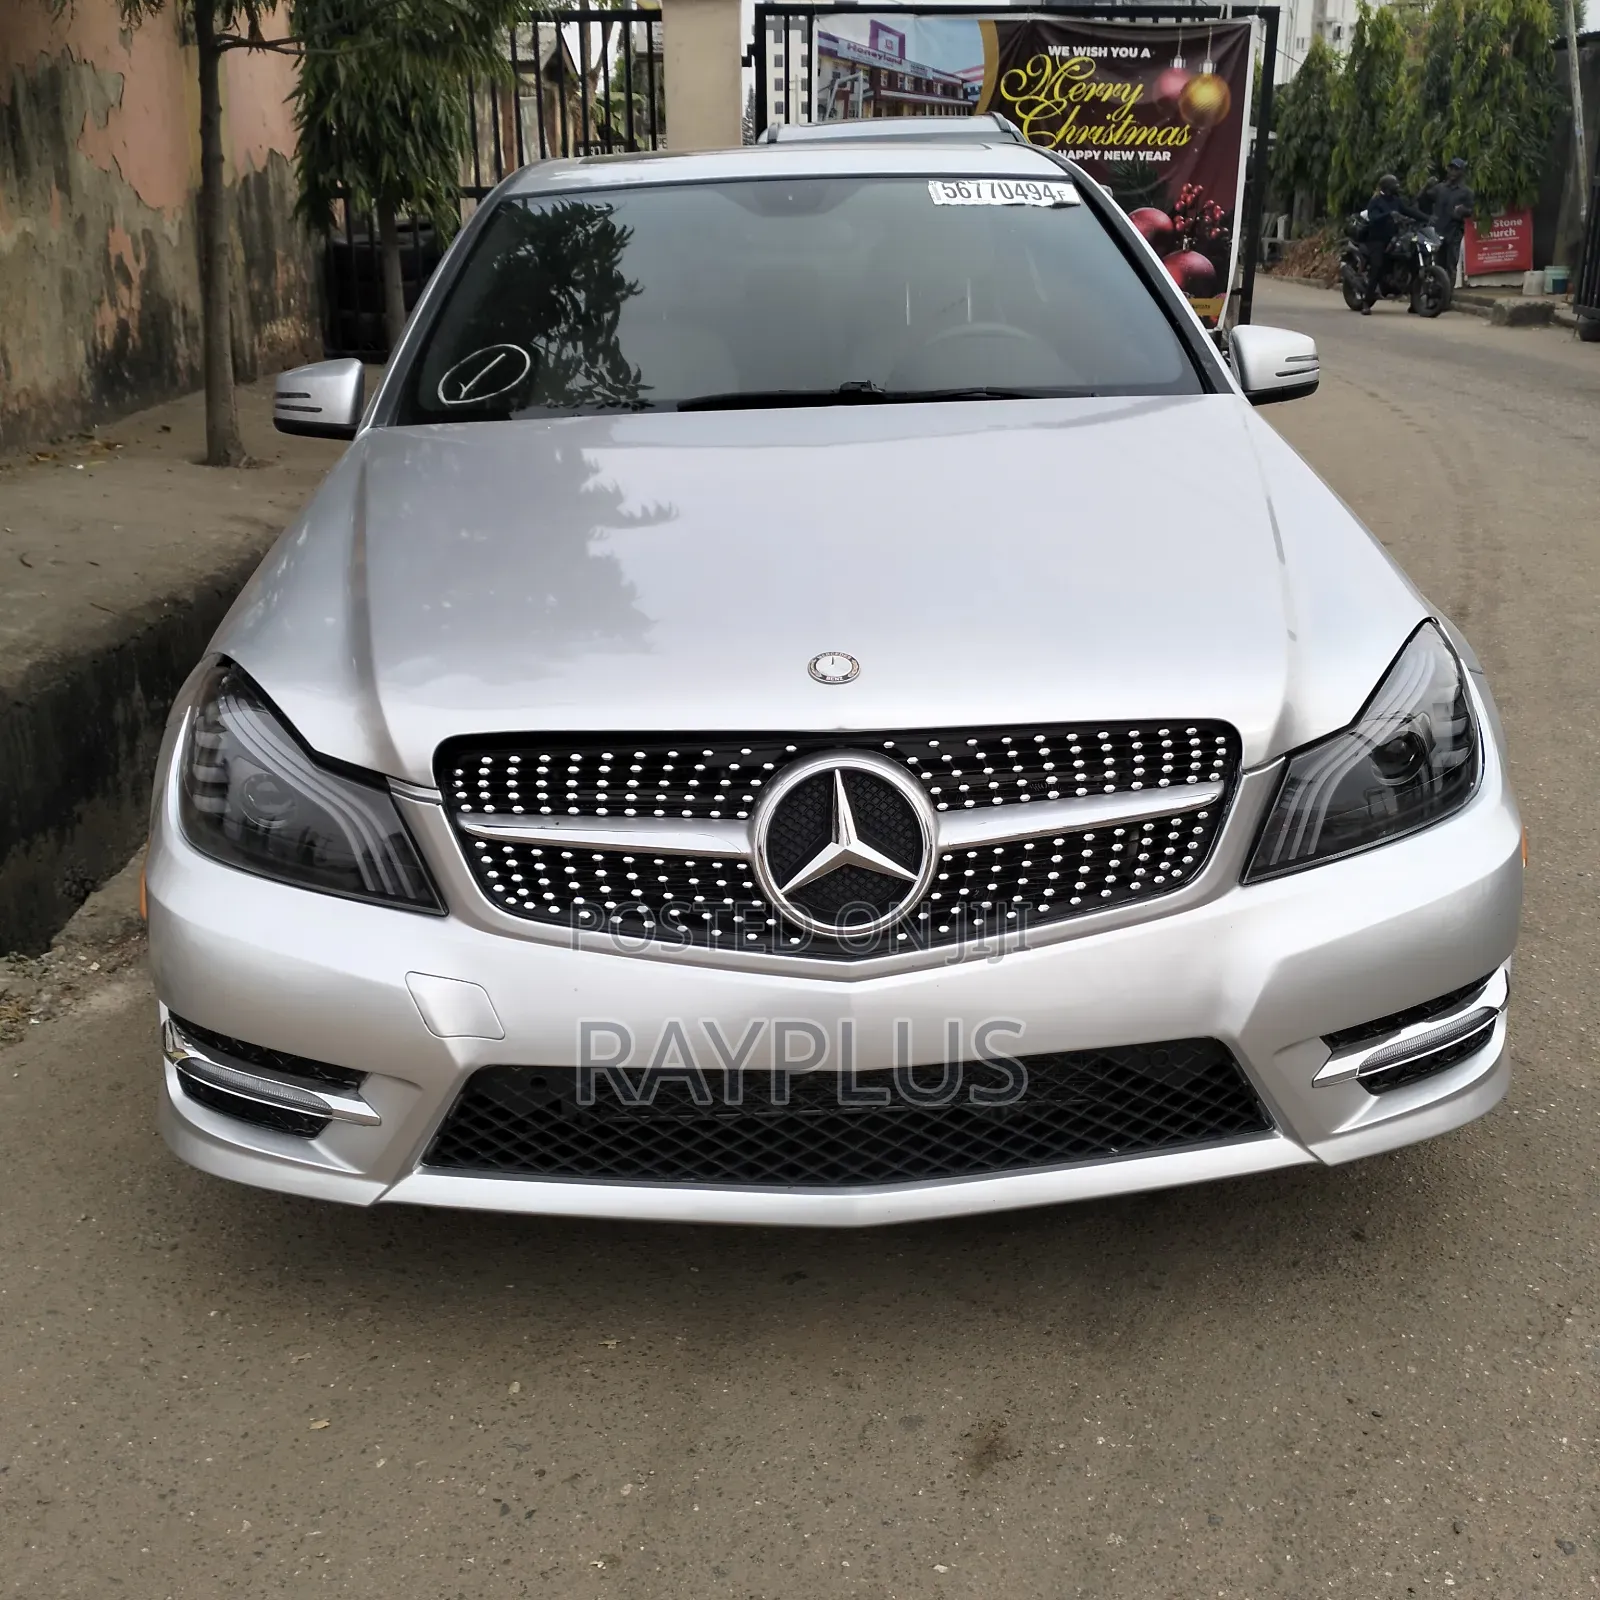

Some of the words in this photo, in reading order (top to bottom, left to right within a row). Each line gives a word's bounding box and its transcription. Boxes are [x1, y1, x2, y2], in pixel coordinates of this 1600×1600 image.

[1048, 45, 1074, 57] WE
[1073, 47, 1107, 58] WISH
[1110, 47, 1138, 58] YOU
[1140, 48, 1151, 58] A
[1001, 54, 1144, 122] Merry
[1015, 97, 1192, 149] Christmas
[1058, 150, 1101, 161] HAPPY
[1104, 151, 1136, 161] NEW
[1137, 151, 1172, 162] YEAR
[1493, 219, 1523, 228] Stone
[1480, 228, 1516, 238] urch
